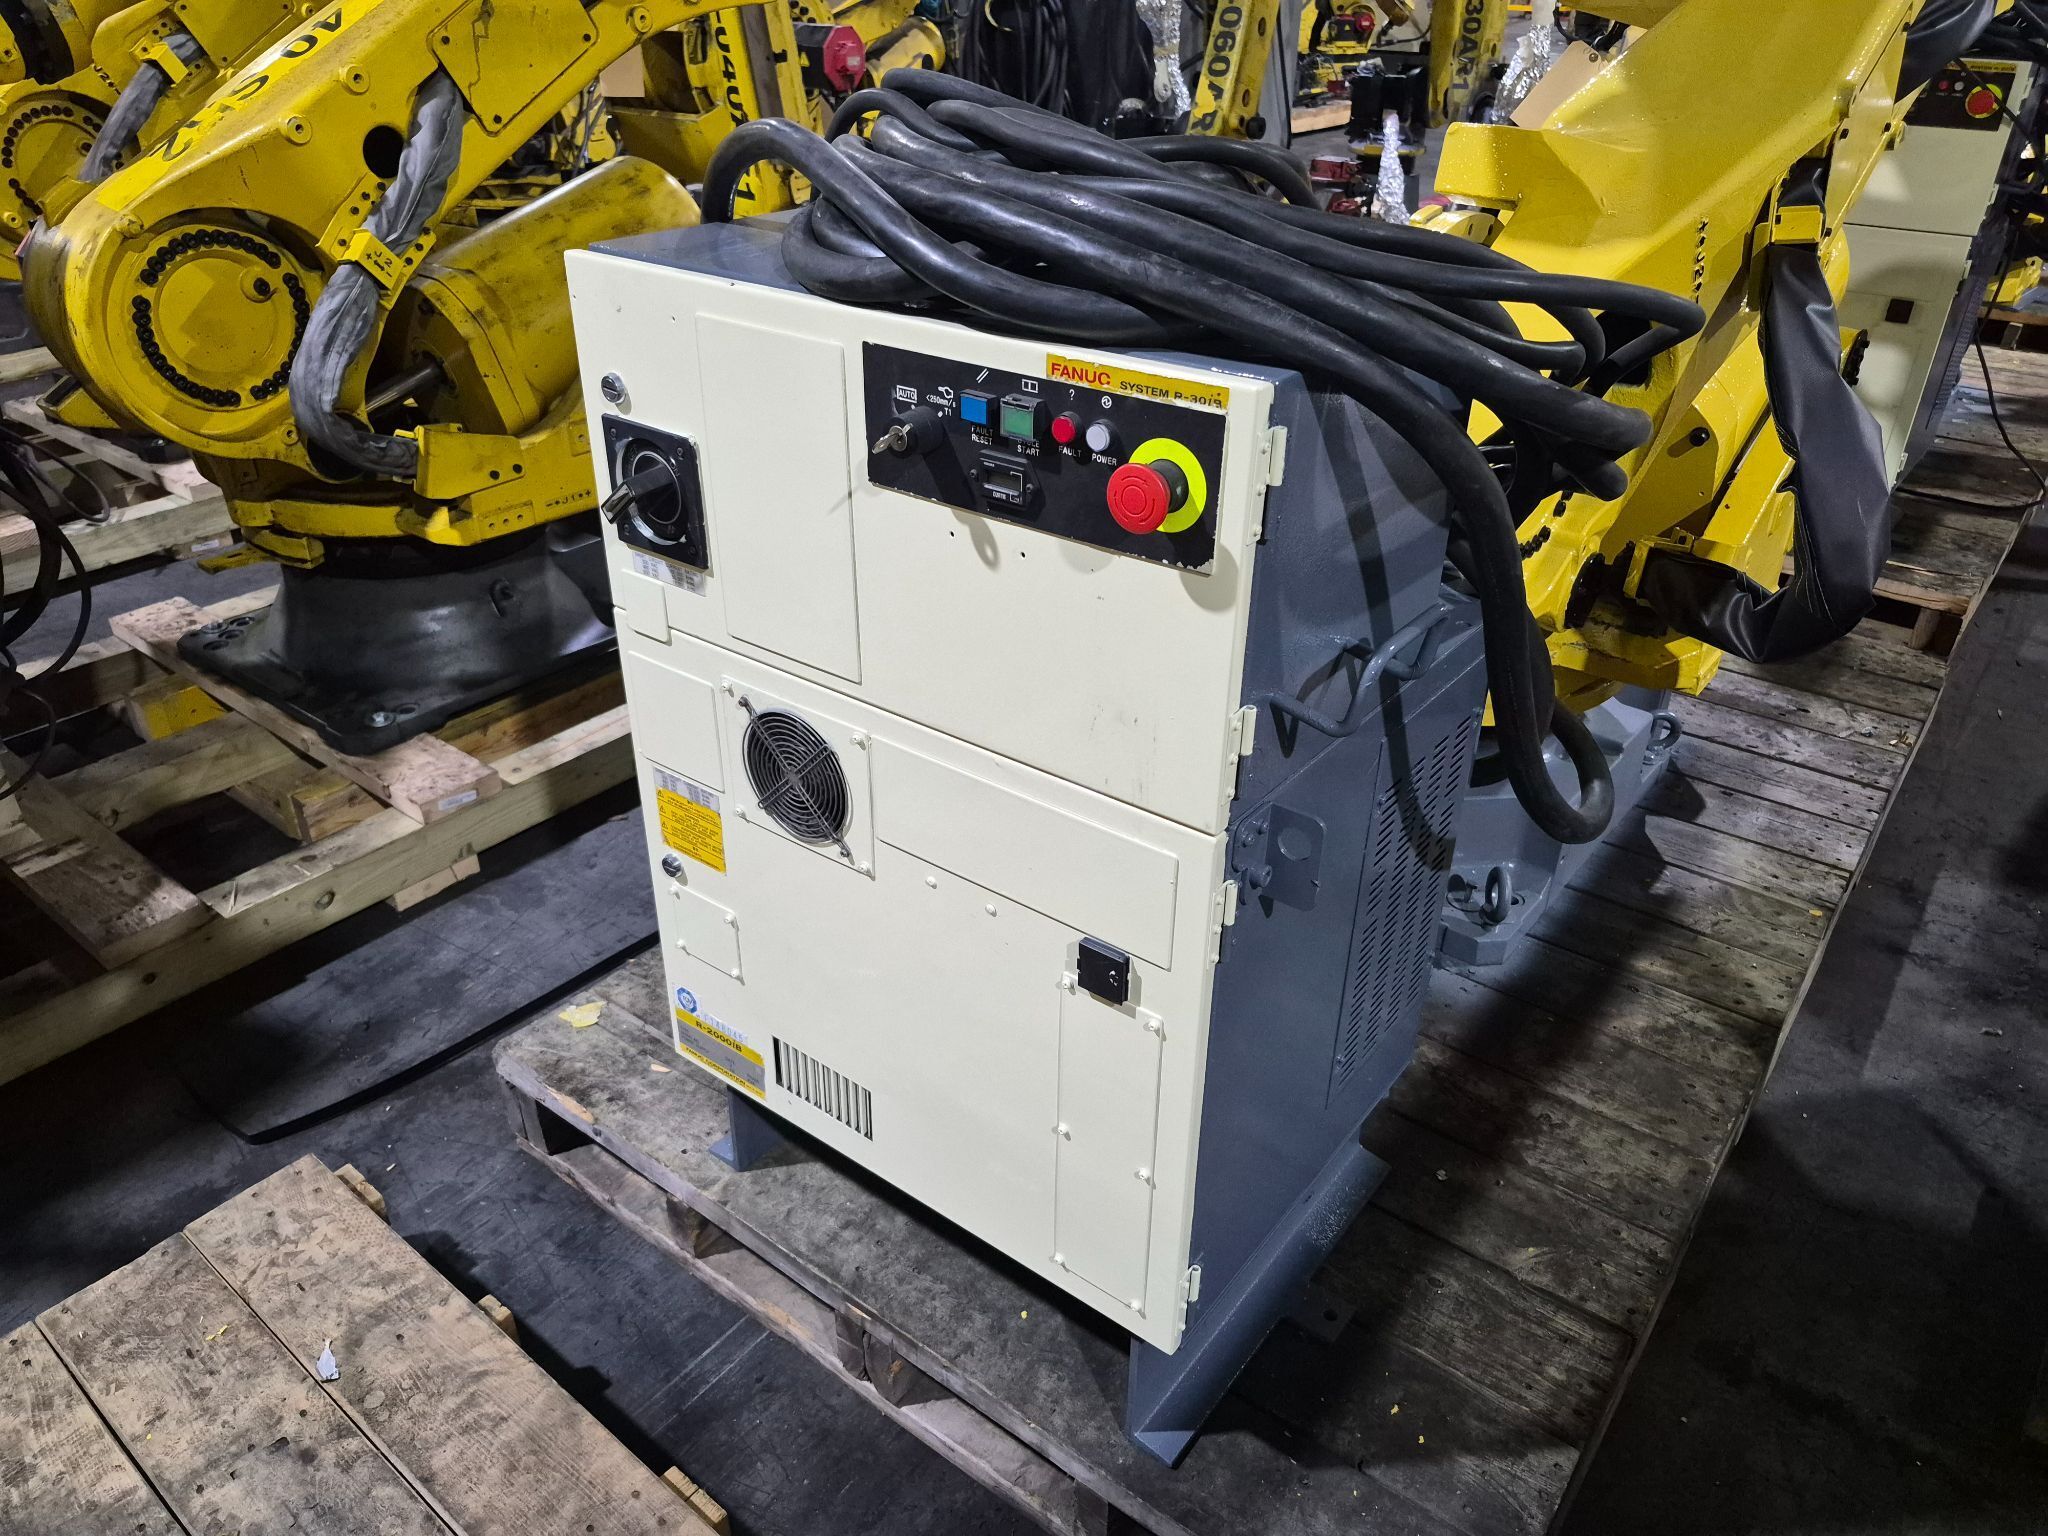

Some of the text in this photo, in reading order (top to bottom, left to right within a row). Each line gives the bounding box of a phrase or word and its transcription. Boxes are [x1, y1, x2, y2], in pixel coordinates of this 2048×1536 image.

[1051, 362, 1111, 385] FANUC
[1119, 380, 1169, 399] SYSTEM
[899, 388, 916, 400] AUTO
[971, 425, 994, 437] FAULT
[971, 433, 993, 446] RESET
[1017, 444, 1040, 457] START
[1059, 445, 1082, 458] FAULT
[1091, 453, 1118, 466] POWER
